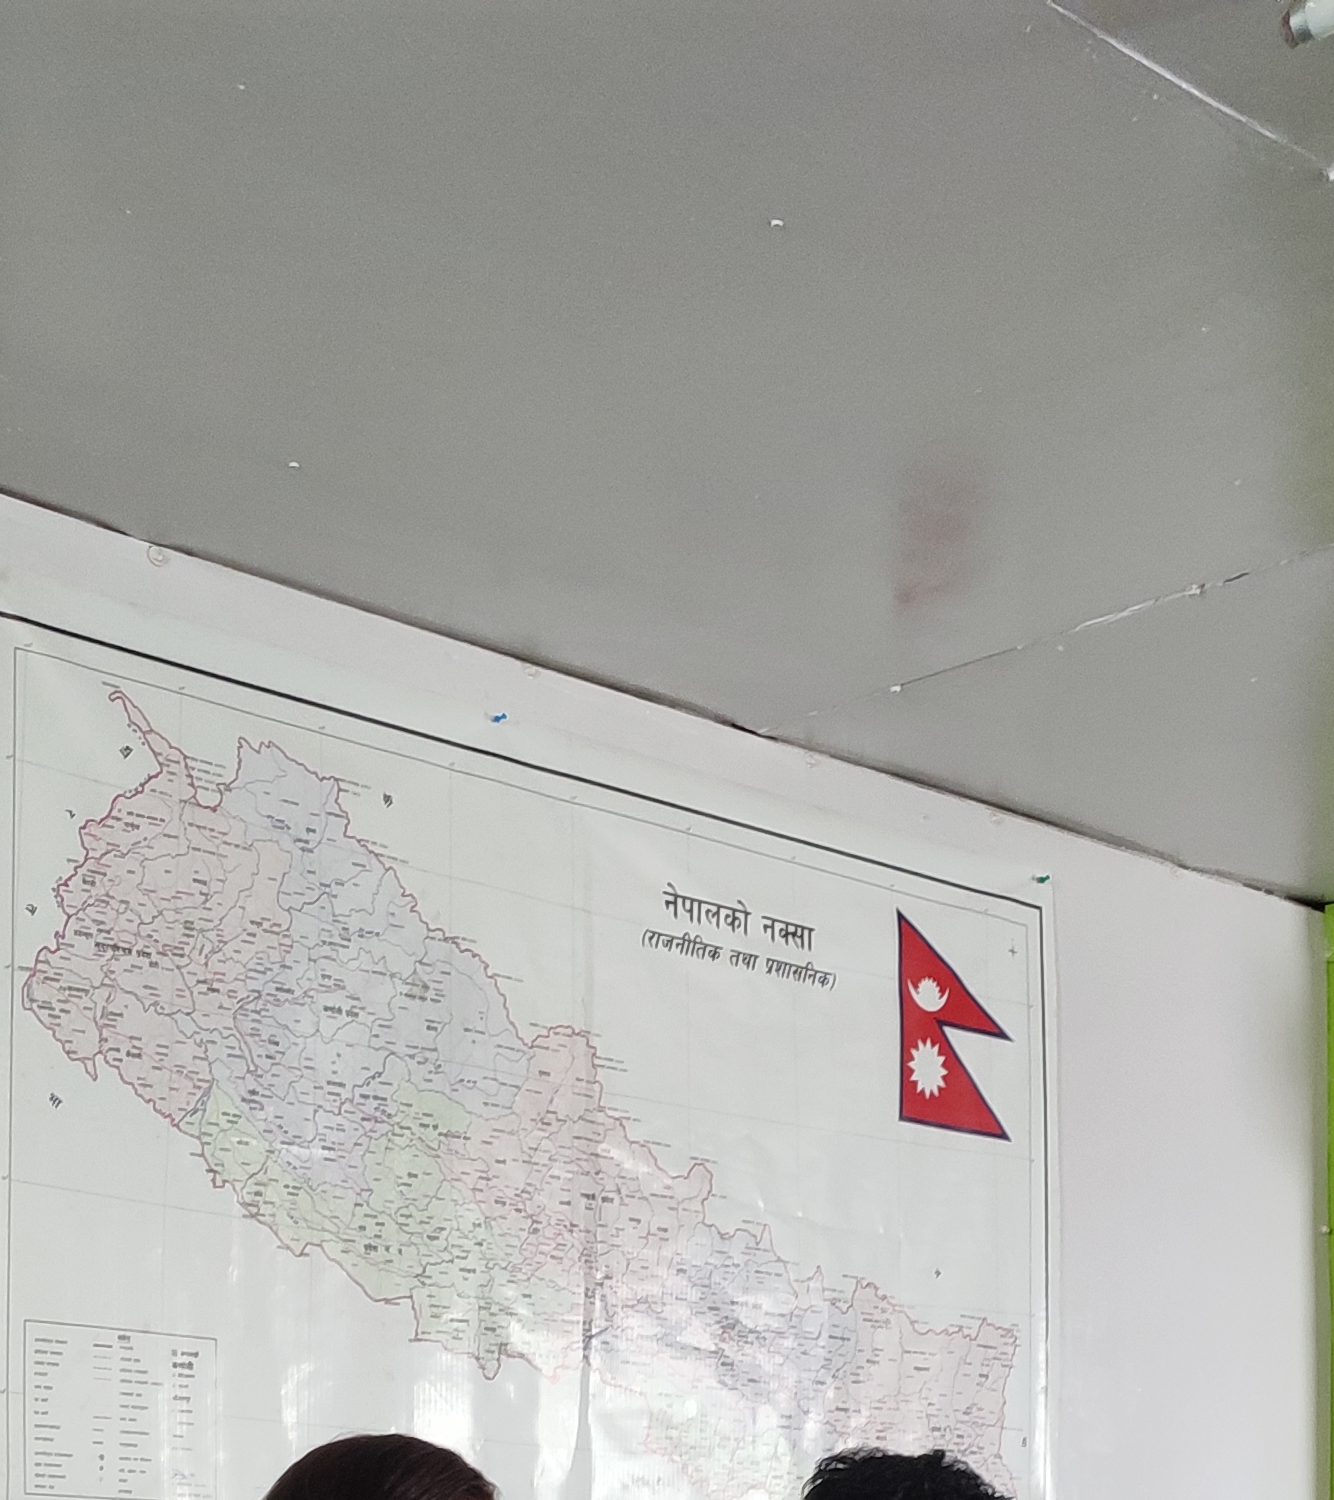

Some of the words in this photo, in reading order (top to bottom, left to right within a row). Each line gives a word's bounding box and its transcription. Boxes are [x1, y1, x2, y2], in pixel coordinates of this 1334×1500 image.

[663, 882, 751, 936] नेपालको
[762, 915, 815, 951] नक्सा
[642, 928, 723, 962] (राजनीतिक
[730, 949, 758, 971] तथा
[765, 957, 837, 990] प्रशासनिक)
